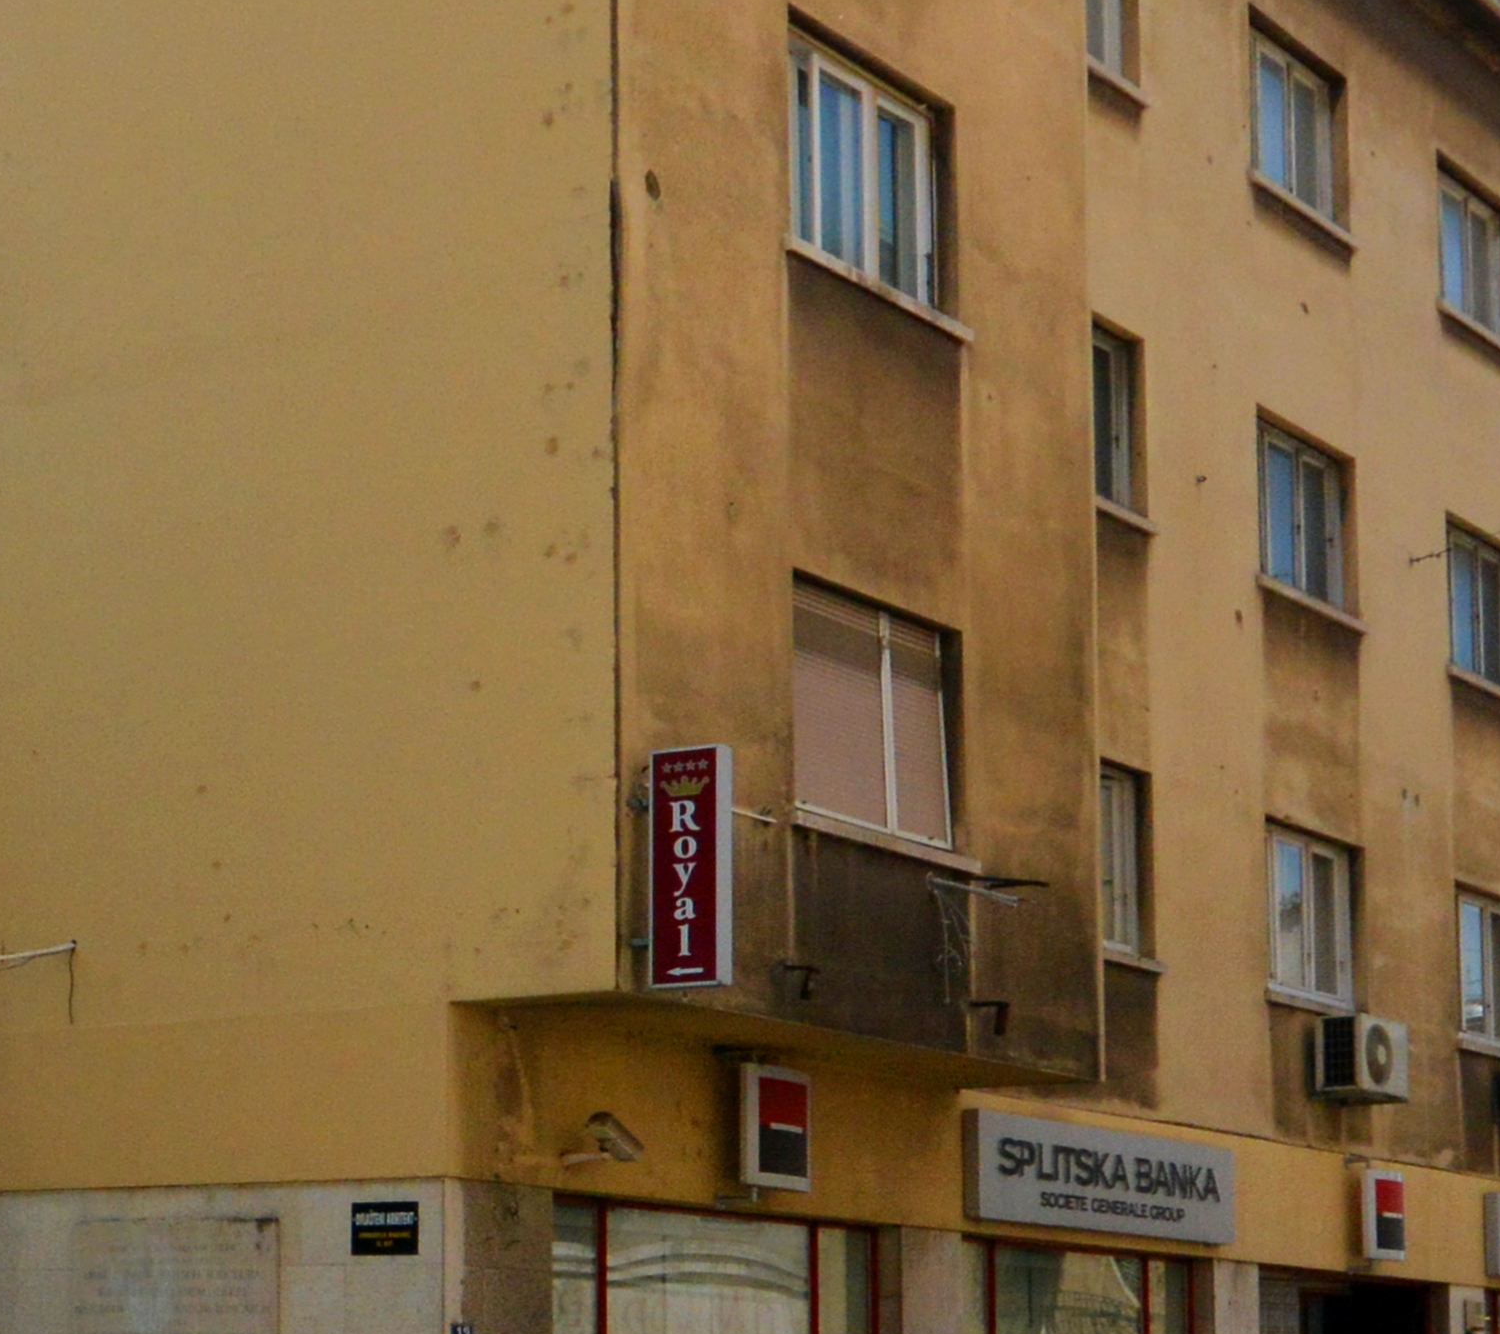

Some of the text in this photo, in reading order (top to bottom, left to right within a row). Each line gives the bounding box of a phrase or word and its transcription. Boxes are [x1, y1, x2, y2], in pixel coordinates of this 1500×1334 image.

[669, 799, 701, 957] Royal
[997, 1137, 1221, 1203] SPLITSKA BANKA
[1040, 1191, 1185, 1223] SOCIETE GENERALE GROUP
